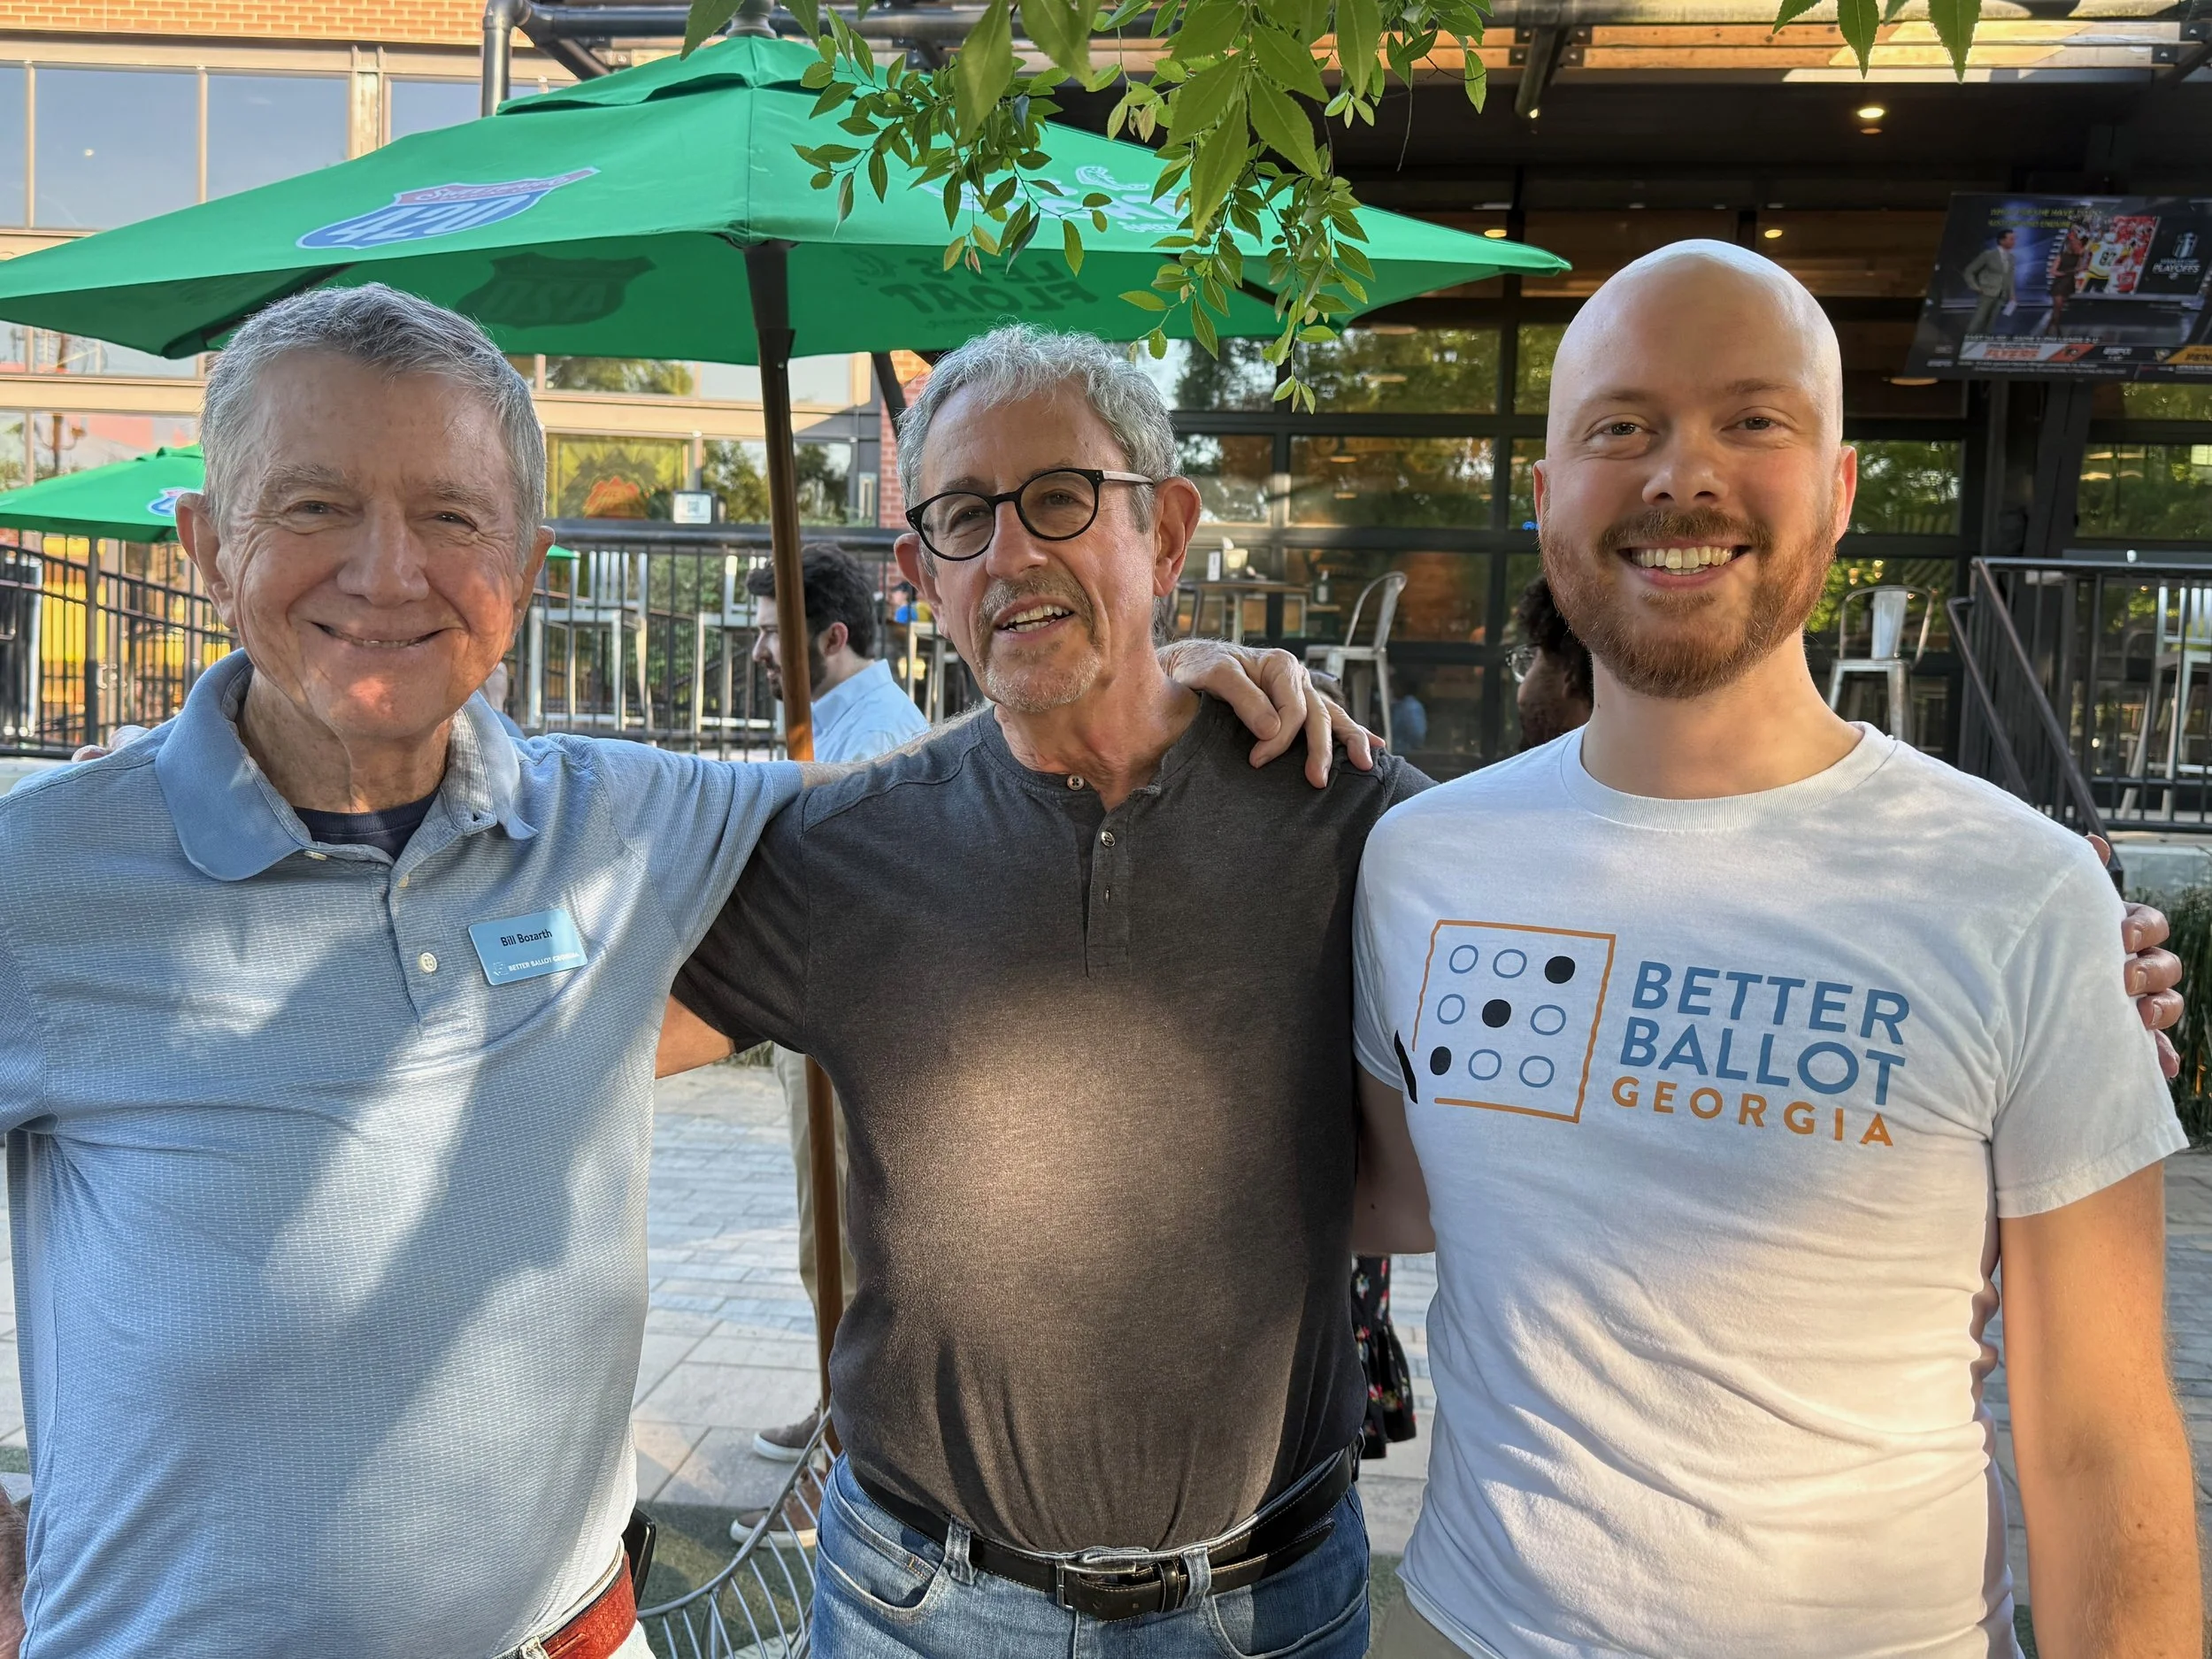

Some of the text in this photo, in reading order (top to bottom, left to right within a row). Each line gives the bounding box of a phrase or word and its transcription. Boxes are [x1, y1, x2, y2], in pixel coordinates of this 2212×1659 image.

[327, 194, 530, 243] 420
[500, 929, 553, 947] Bill Bozarth
[508, 961, 531, 972] BETTER
[530, 956, 553, 967] BALLOT
[1632, 960, 1910, 1046] BETTER
[1619, 1016, 1906, 1106] BALLOT
[1611, 1076, 1894, 1148] GEORGIA
